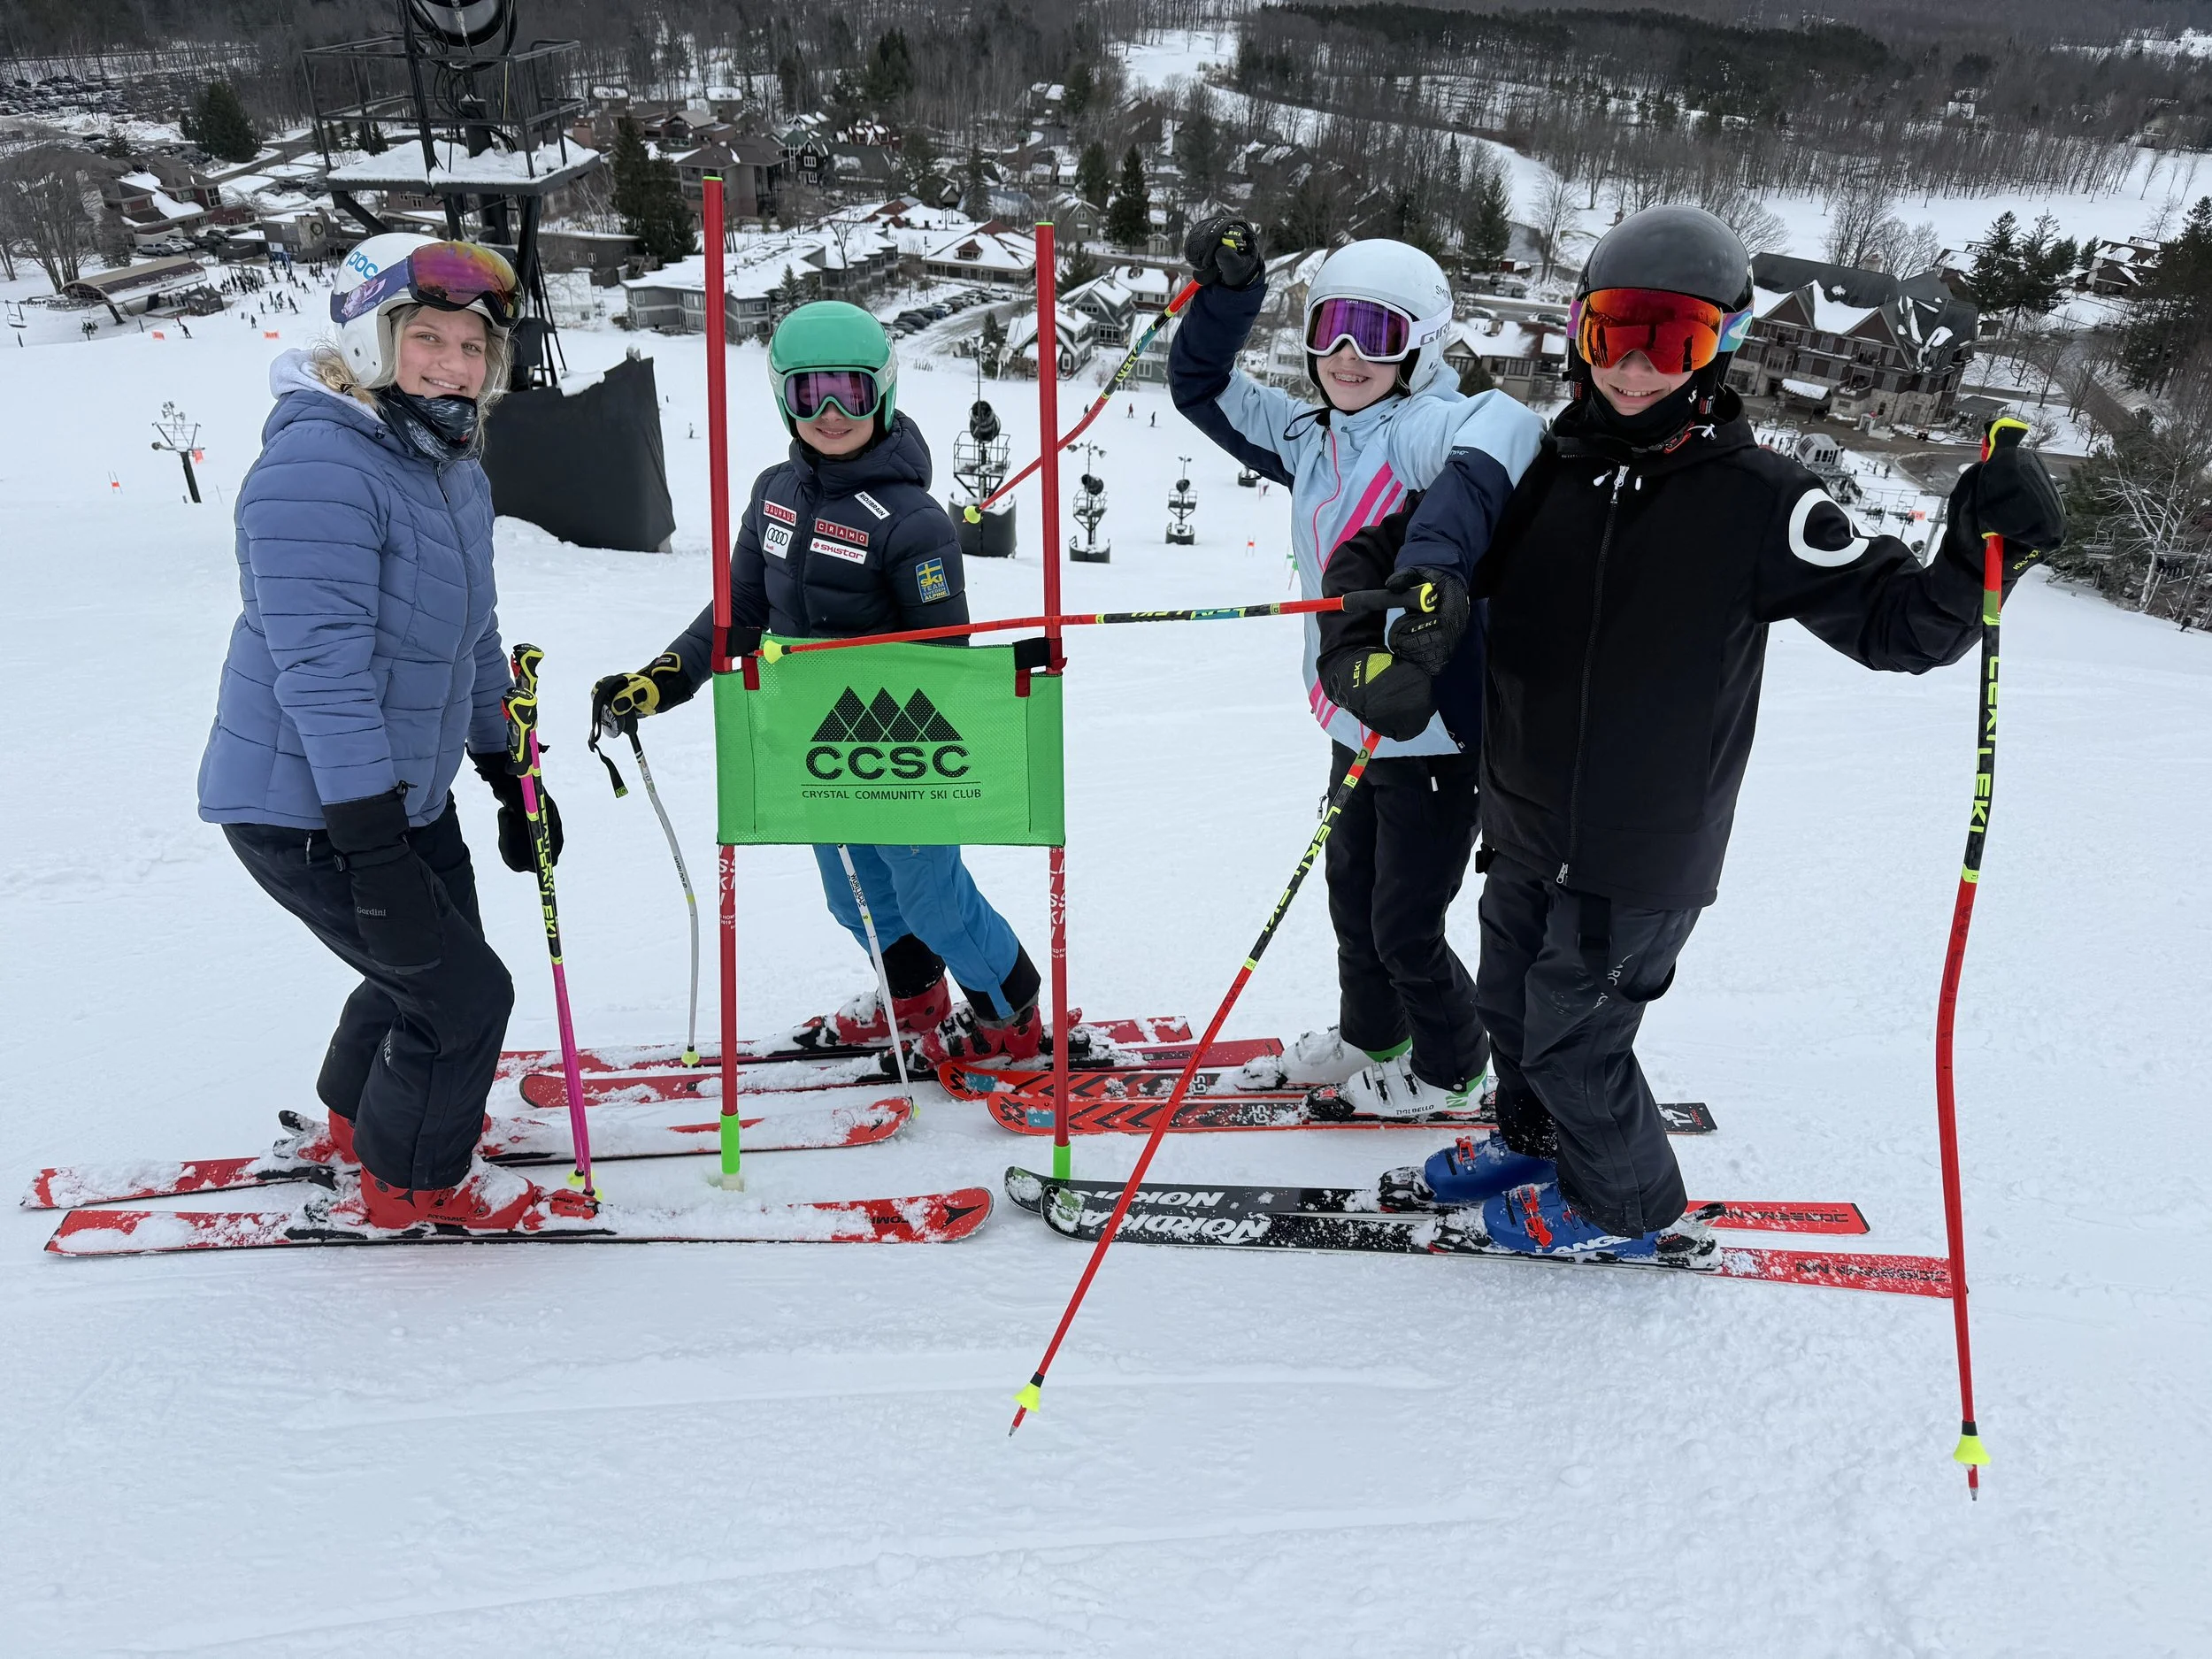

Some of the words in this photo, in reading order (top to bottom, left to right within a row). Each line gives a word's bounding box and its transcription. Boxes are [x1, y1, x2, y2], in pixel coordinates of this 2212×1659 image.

[765, 503, 795, 522] BAUHAUS
[859, 493, 886, 517] RIDEBRAIN
[818, 523, 865, 542] CRAMO
[1410, 619, 1438, 633] LEKI
[1352, 660, 1362, 688] LEKI
[806, 744, 972, 780] CCSC
[802, 789, 850, 800] CRYSTAL
[855, 789, 926, 801] COMMUNITY
[930, 789, 948, 800] SKI
[952, 788, 982, 799] CLUB
[1968, 747, 1993, 833] LEKI
[1301, 804, 1342, 870] LEKI
[357, 905, 388, 917] Gordini
[540, 889, 557, 939] LEKI
[426, 1213, 468, 1223] ATOMIC
